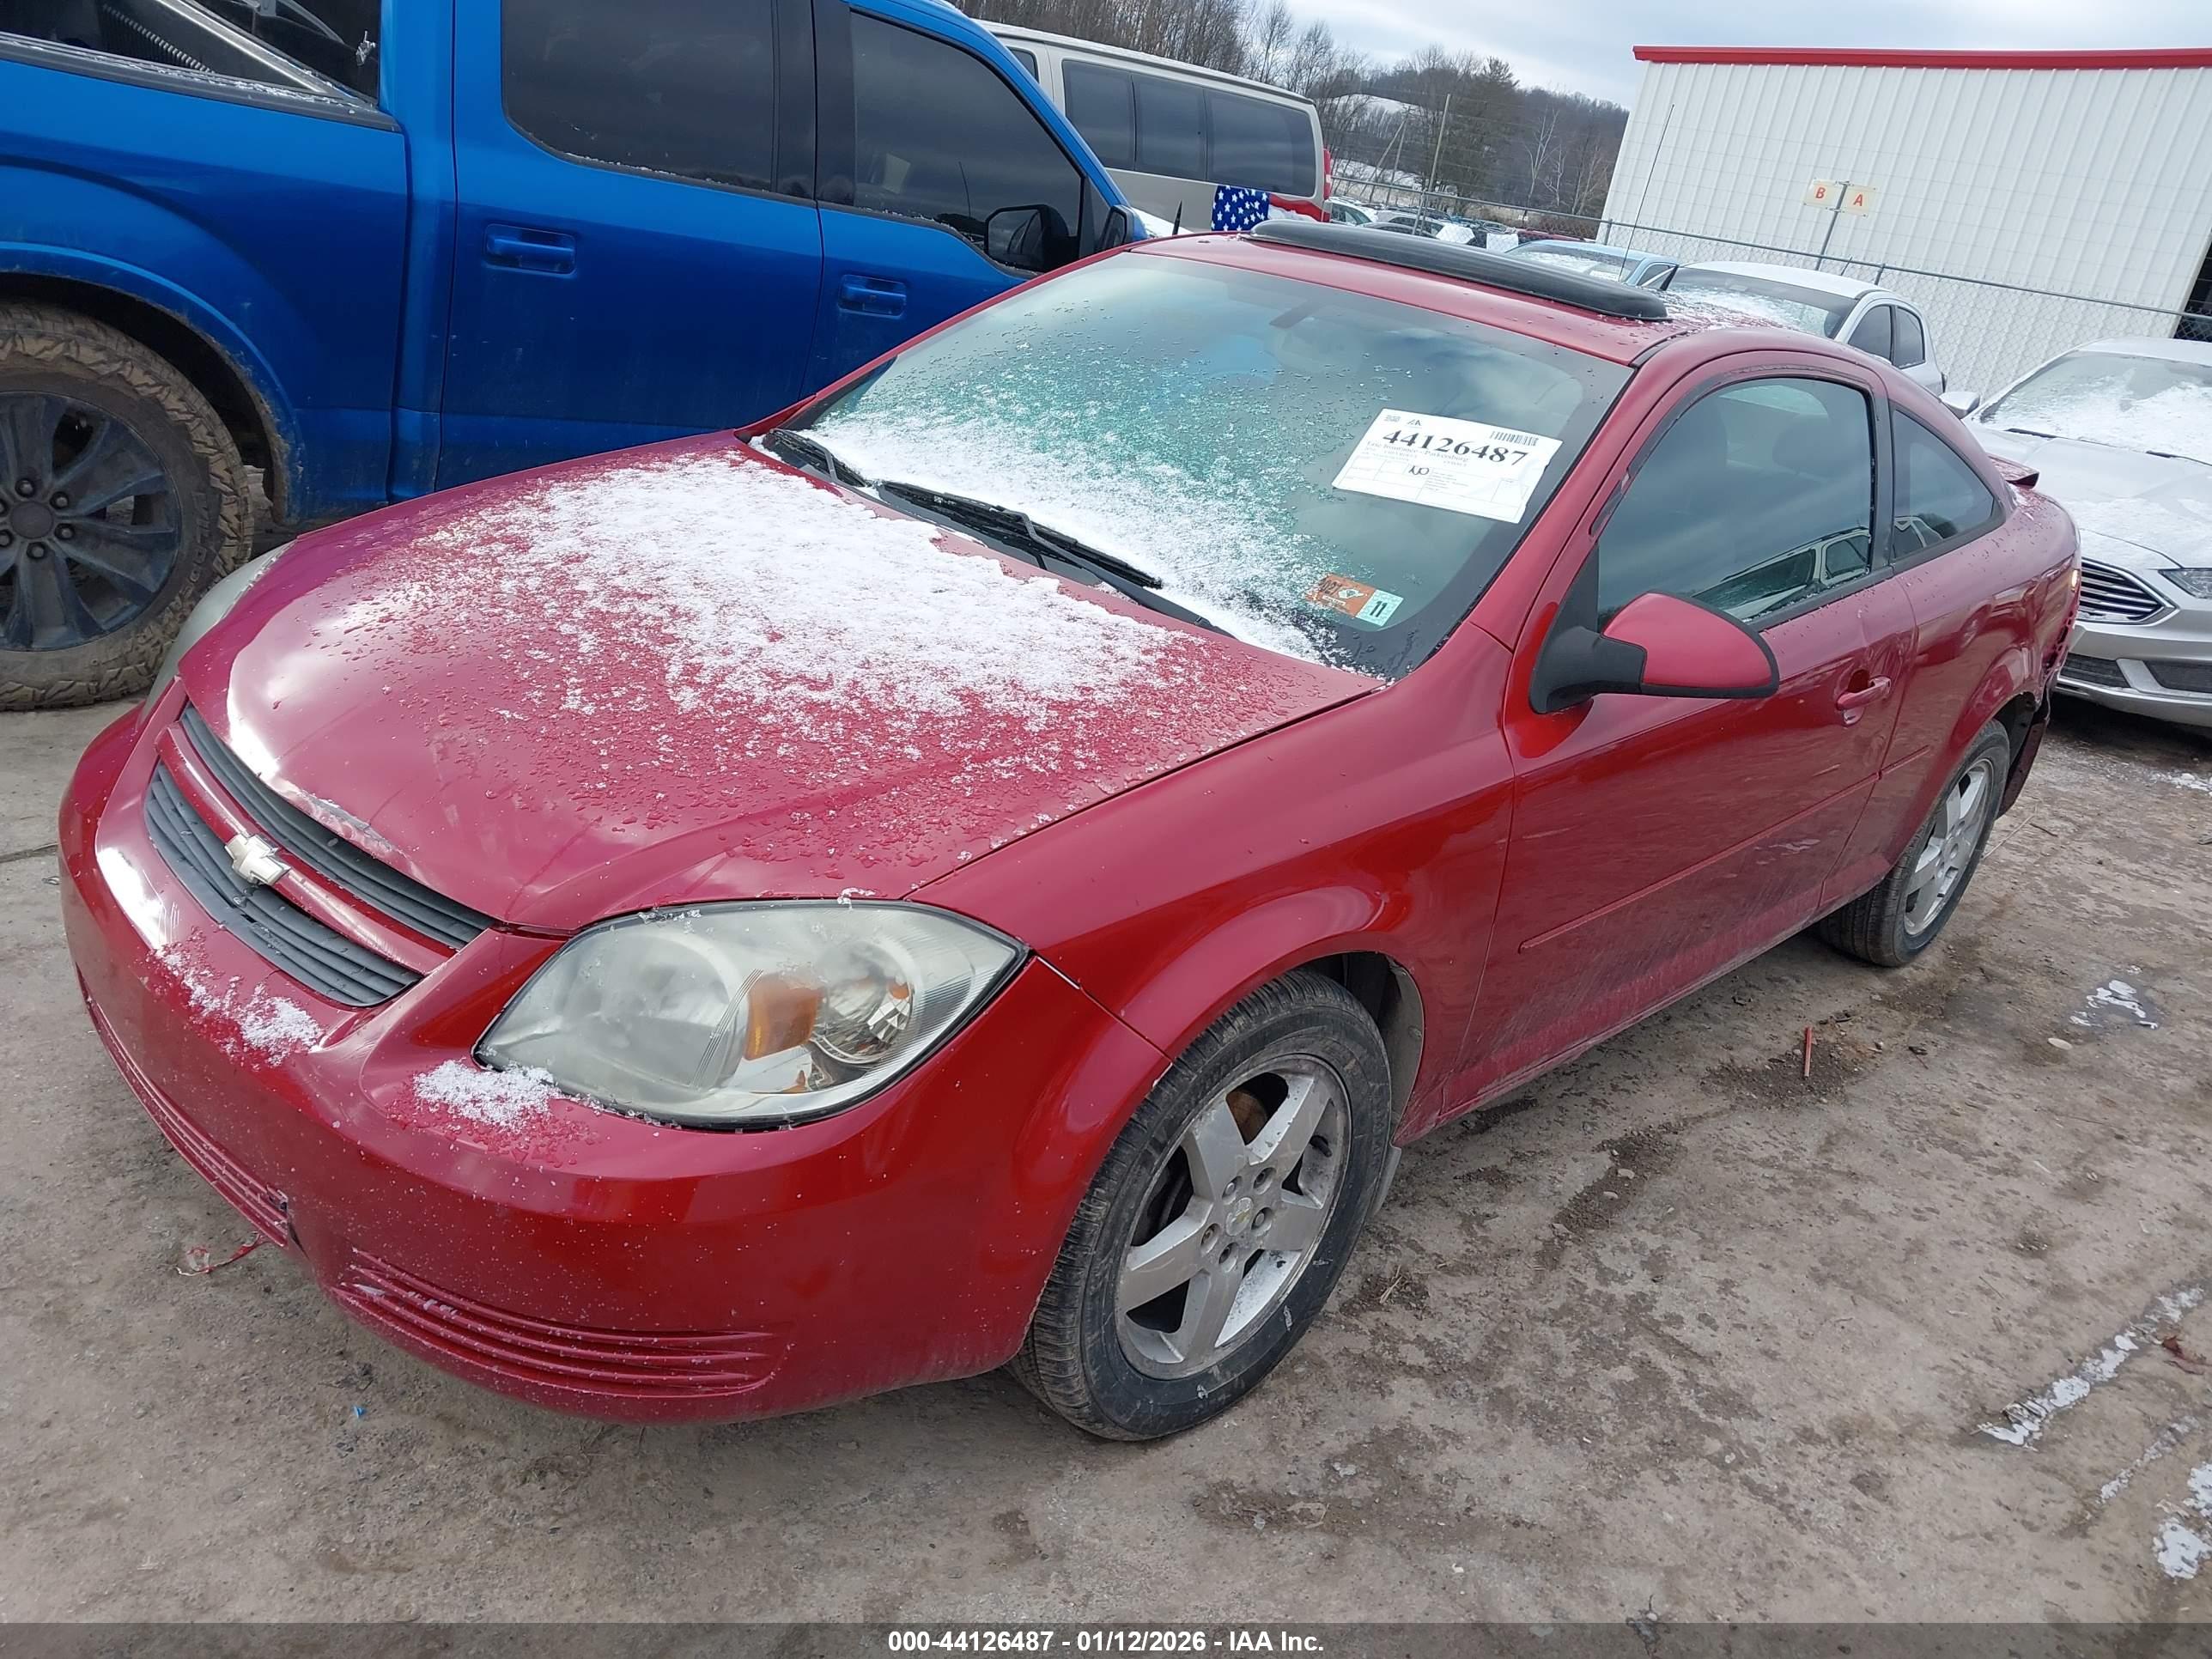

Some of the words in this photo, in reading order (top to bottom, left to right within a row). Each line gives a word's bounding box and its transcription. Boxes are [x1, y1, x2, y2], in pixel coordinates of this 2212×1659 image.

[1815, 186, 1826, 199] B
[1853, 193, 1863, 207] A
[1382, 429, 1529, 466] 44126487
[1370, 600, 1388, 618] 11
